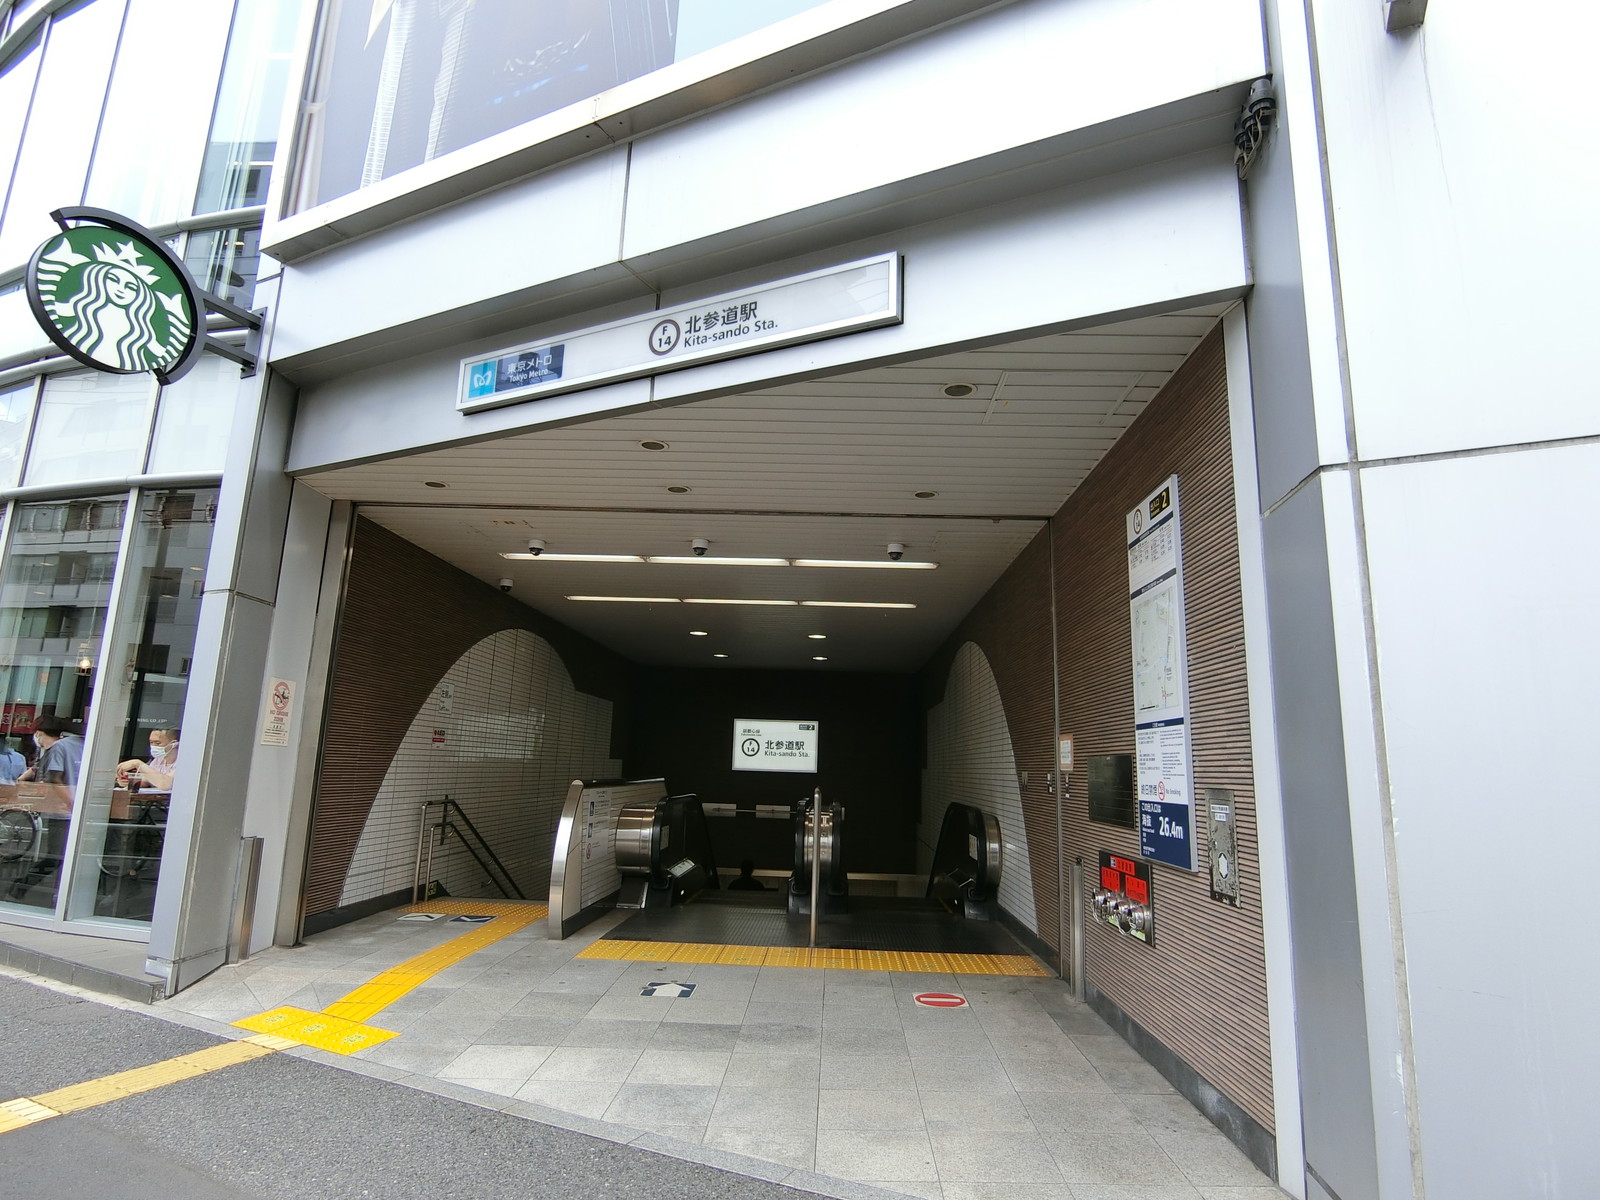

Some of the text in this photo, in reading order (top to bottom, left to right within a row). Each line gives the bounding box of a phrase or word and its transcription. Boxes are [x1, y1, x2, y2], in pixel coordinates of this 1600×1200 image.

[685, 301, 758, 335] 北参道駅
[662, 325, 668, 336] F
[684, 319, 778, 348] Kita-sando Sta.
[658, 336, 672, 348] 14
[507, 354, 552, 375] 東京メトロ
[509, 368, 549, 383] Tokyo Metro
[1161, 491, 1167, 508] 2
[764, 740, 805, 751] 北参道駅
[1159, 816, 1184, 840] 26.4m
